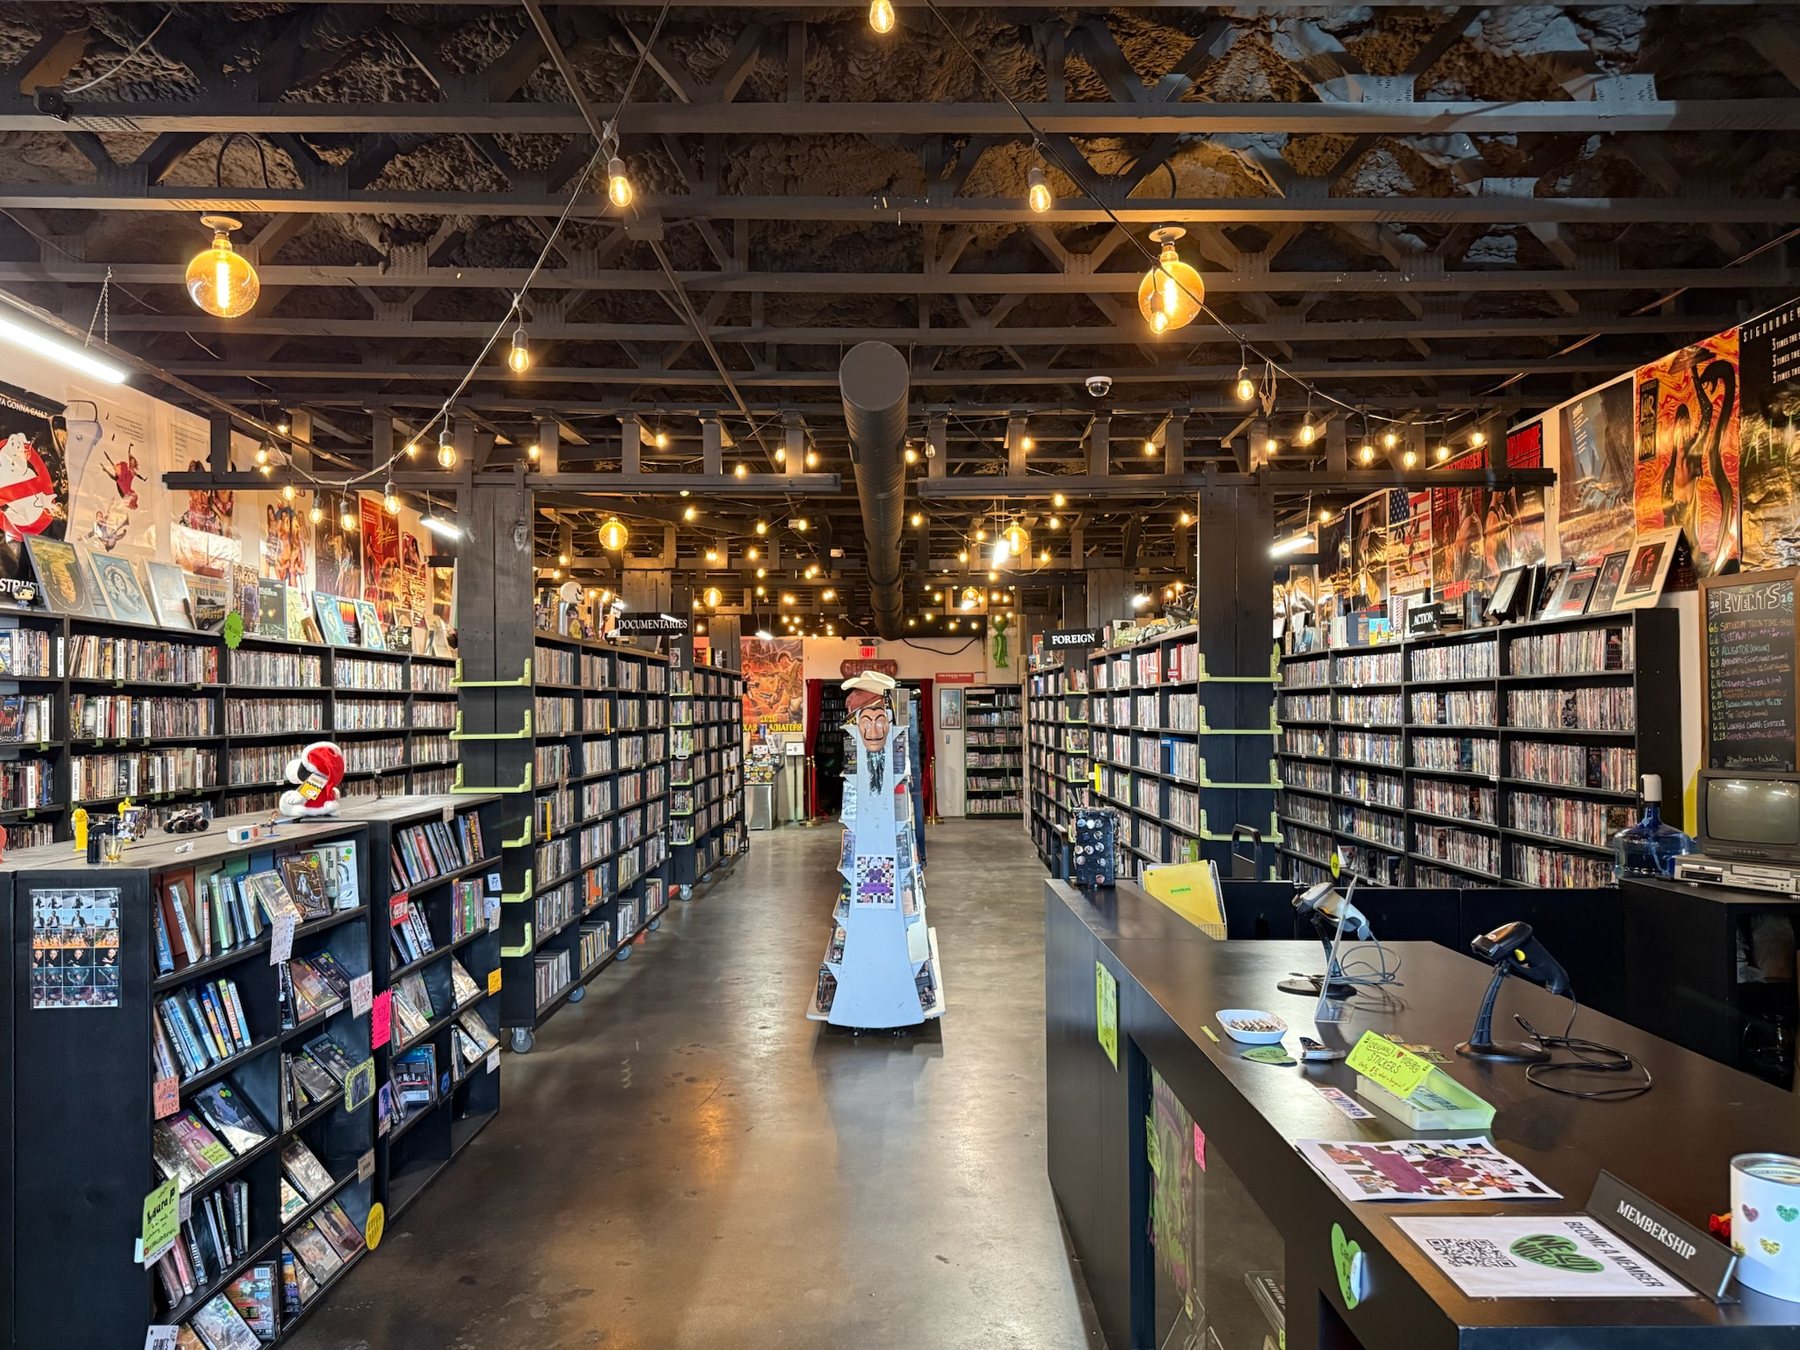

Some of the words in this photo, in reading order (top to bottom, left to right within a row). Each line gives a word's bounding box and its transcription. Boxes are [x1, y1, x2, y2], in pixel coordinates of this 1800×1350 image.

[7, 400, 30, 414] GONNA
[618, 619, 687, 629] DOCUMENTARIES
[1414, 612, 1433, 624] ACTION
[1052, 634, 1095, 644] FOREIGN
[1367, 1052, 1402, 1074] STICKERS
[1616, 1200, 1697, 1260] MEMBERSHIP
[1526, 1235, 1570, 1251] WE
[1513, 1241, 1557, 1265] VIDEO
[1563, 1221, 1608, 1248] BECOME
[1607, 1255, 1665, 1287] MEMBER
